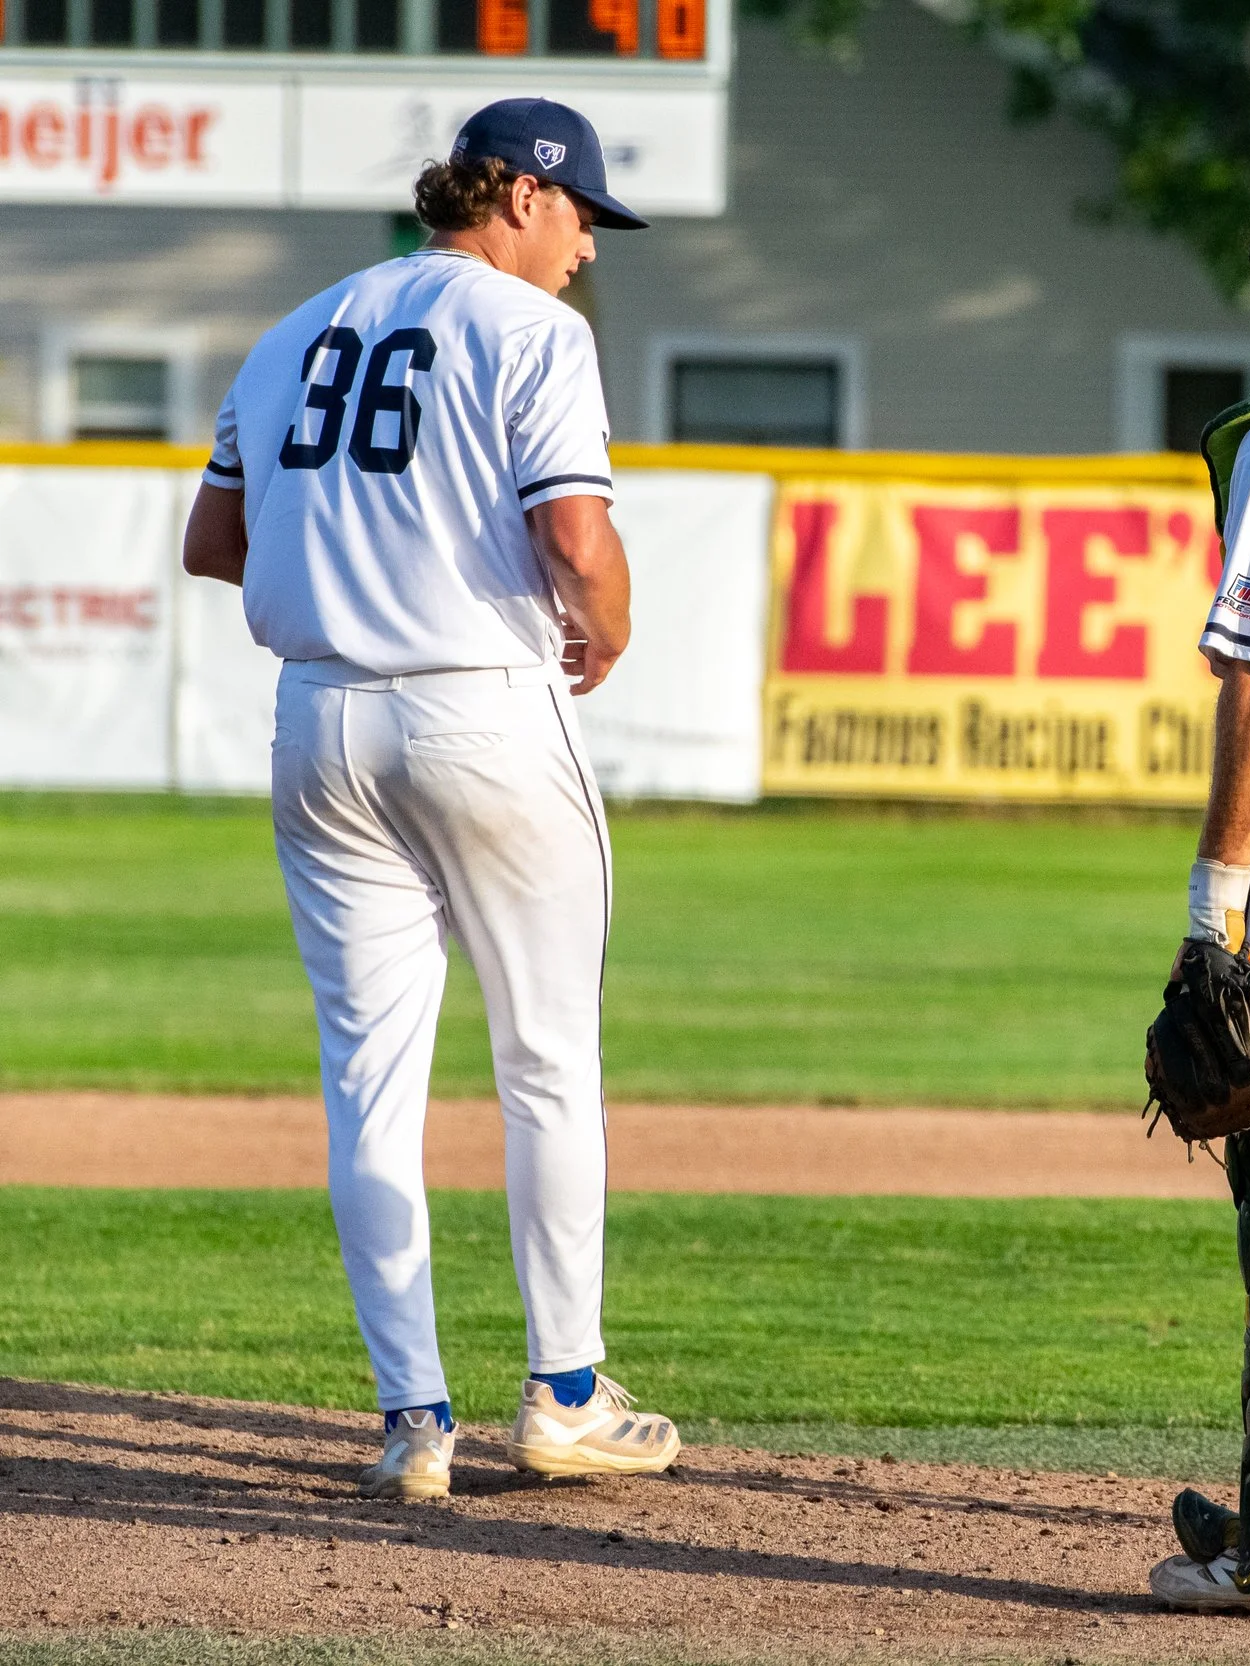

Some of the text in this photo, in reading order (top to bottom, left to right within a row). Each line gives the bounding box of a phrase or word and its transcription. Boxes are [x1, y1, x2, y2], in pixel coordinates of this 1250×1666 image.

[0, 78, 222, 193] eijer
[278, 326, 438, 475] 36
[782, 498, 1224, 678] LEE'
[772, 692, 940, 768] Famous
[960, 697, 1116, 780] Recipe
